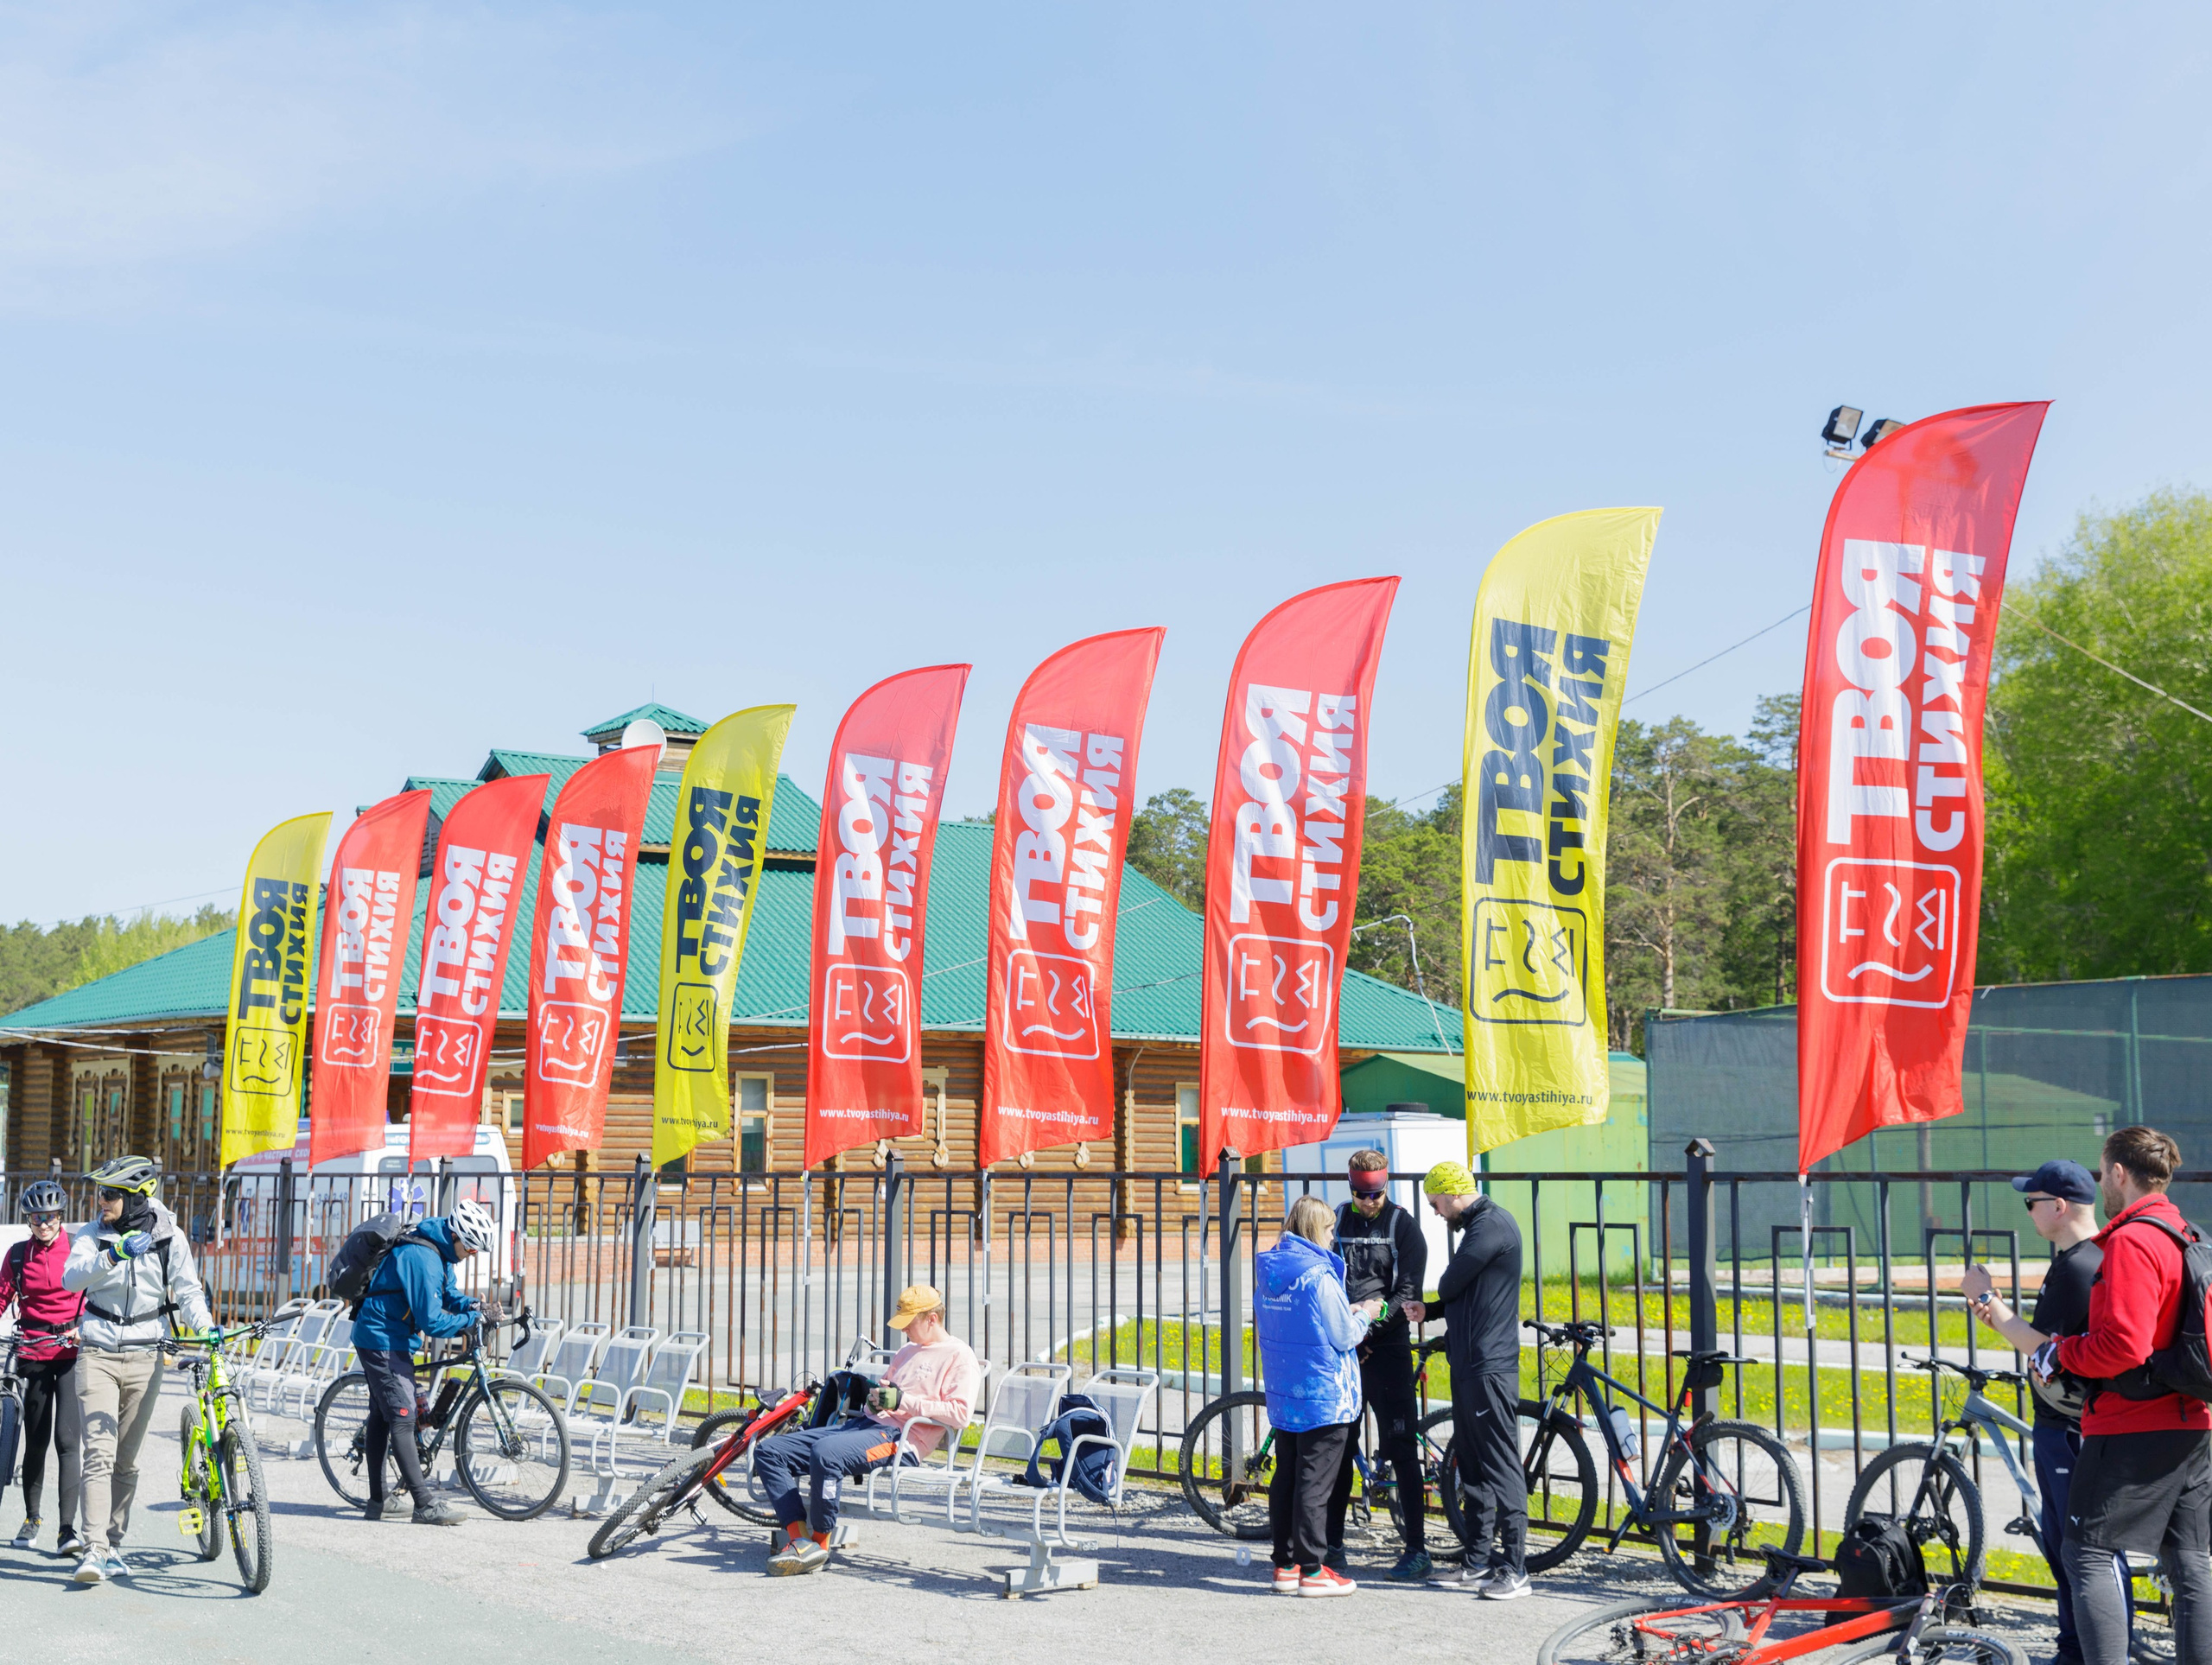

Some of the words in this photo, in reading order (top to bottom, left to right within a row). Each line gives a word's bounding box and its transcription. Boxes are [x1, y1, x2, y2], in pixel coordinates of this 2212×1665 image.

[1474, 617, 1557, 886] ТВОЯ
[1548, 632, 1611, 897] СТИХИЯ
[1826, 537, 1926, 845] ТВОЯ
[1915, 549, 1986, 852] СТИХИЯ
[676, 785, 734, 974] ТВОЯ
[699, 794, 761, 976] СТИХИЯ
[827, 752, 895, 956] ТВОЯ
[884, 761, 933, 962] СТИХИЯ
[1008, 722, 1082, 941] ТВОЯ
[1064, 733, 1124, 950] СТИХИЯ
[1230, 683, 1313, 925] ТВОЯ
[1298, 692, 1357, 931] СТИХИЯ
[238, 877, 289, 1020] ТВОЯ
[279, 882, 308, 1026] СТИХИЯ
[330, 867, 374, 999] ТВОЯ
[362, 871, 401, 1002] СТИХИЯ
[418, 844, 486, 1008] ТВОЯ
[461, 852, 518, 1016] СТИХИЯ
[543, 823, 602, 995] ТВОЯ
[588, 829, 628, 1002] СТИХИЯ
[819, 1108, 910, 1122] www.tvoyastihiya.ru
[997, 1105, 1099, 1126] www.tvoyastihiya.ru
[1221, 1106, 1329, 1126] www.tvoyastihiya.ru
[1466, 1089, 1592, 1107] www.tvoyastihiya.ru
